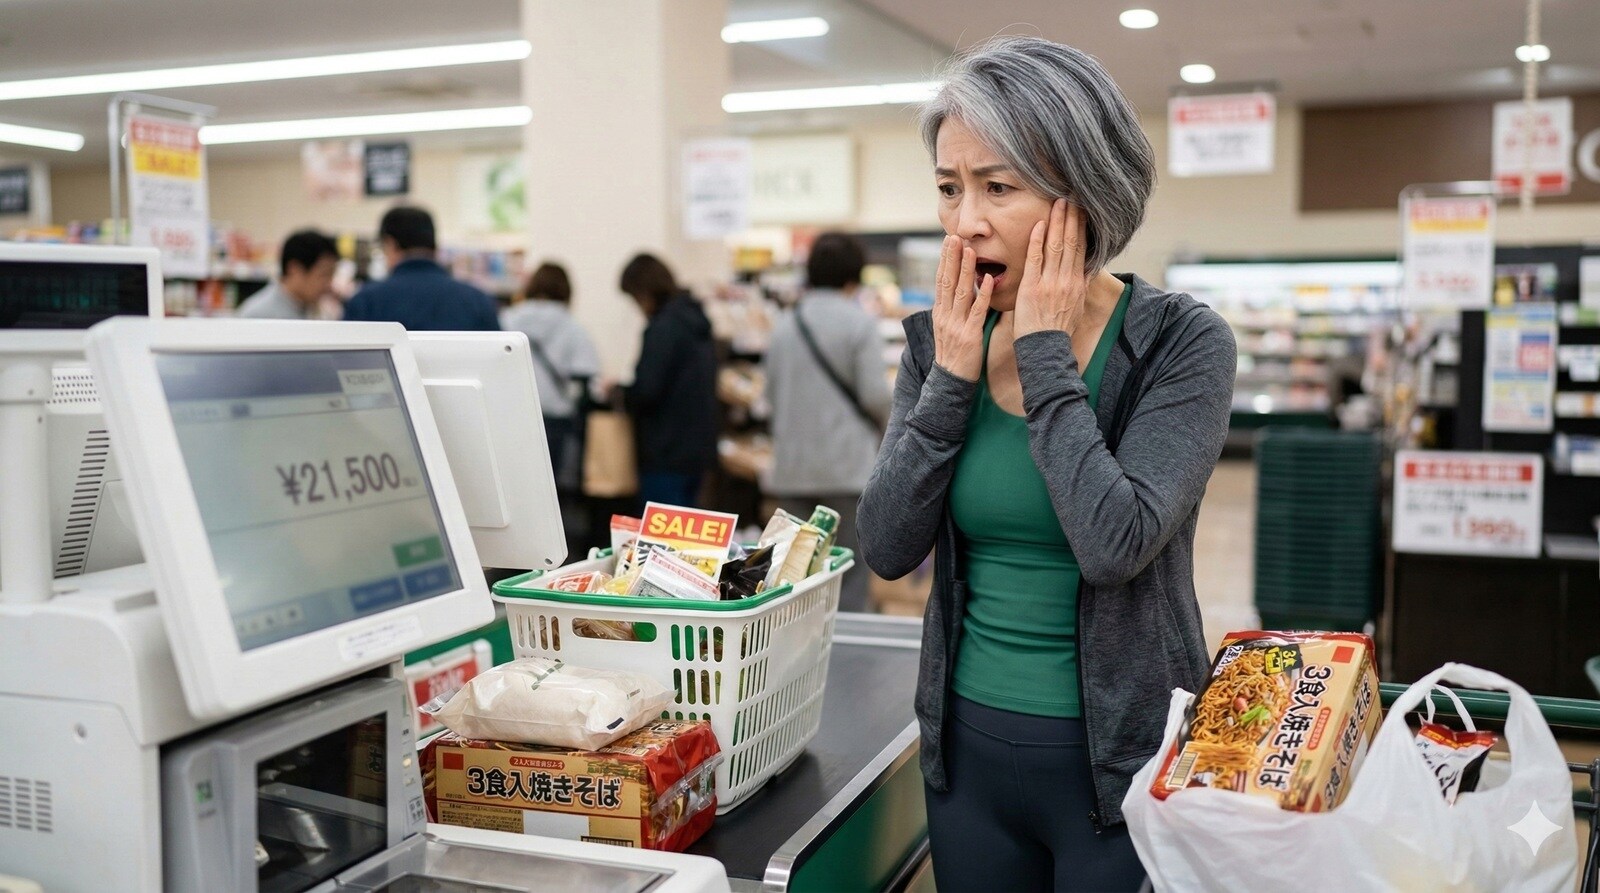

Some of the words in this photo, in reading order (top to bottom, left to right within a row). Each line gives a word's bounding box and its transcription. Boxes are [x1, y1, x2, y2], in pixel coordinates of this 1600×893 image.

[276, 452, 401, 505] ¥21,500
[648, 512, 728, 543] SALE!
[1259, 665, 1331, 788] 3食入焼きそば
[467, 767, 621, 807] 3食入焼きそば
